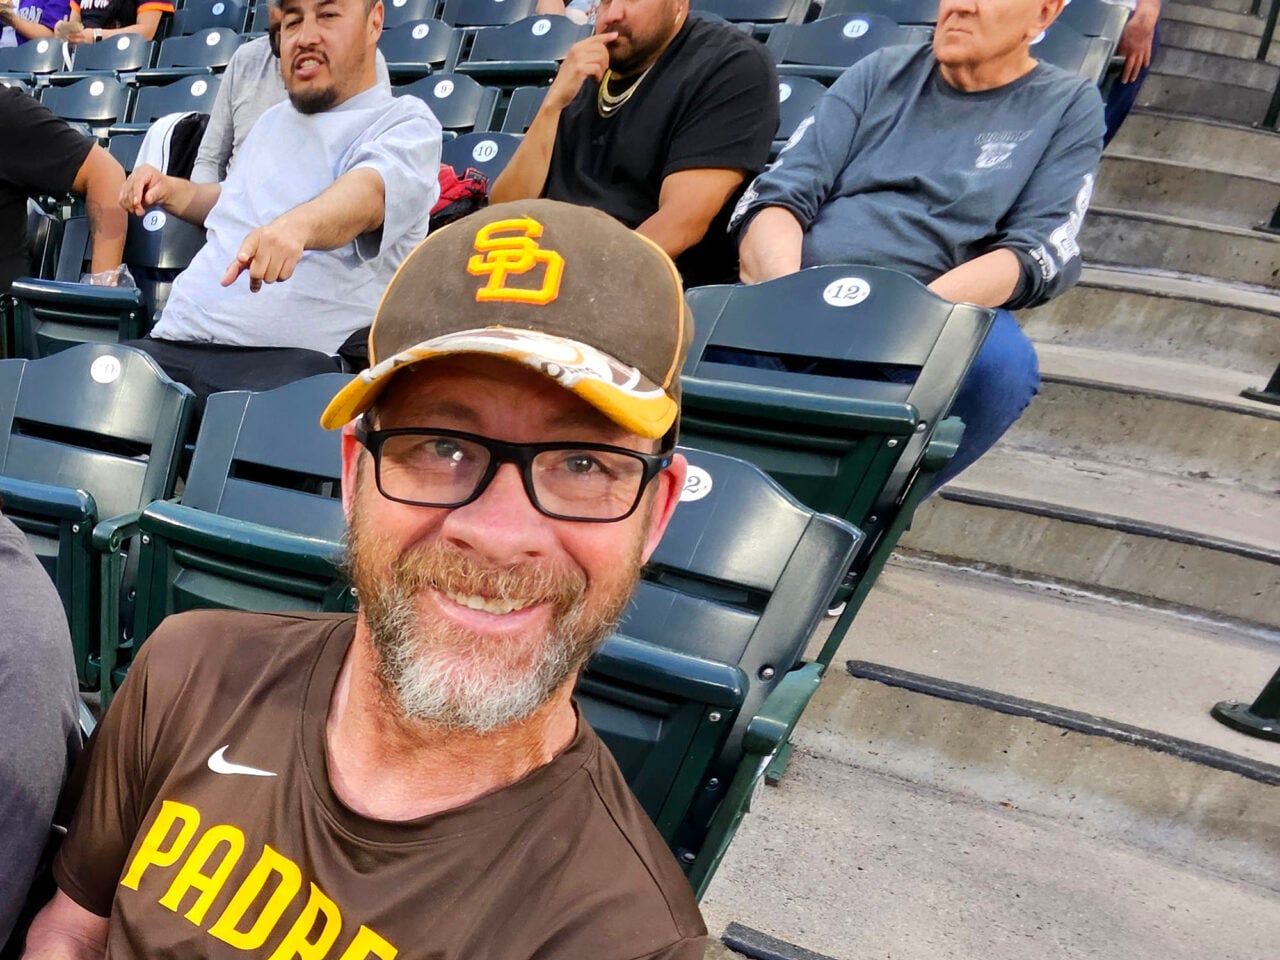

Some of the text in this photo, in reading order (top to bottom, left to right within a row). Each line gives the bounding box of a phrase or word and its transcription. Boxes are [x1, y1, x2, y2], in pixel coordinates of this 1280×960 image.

[477, 145, 493, 157] 10
[467, 217, 565, 306] SD
[831, 284, 861, 300] 12
[682, 475, 701, 494] 2
